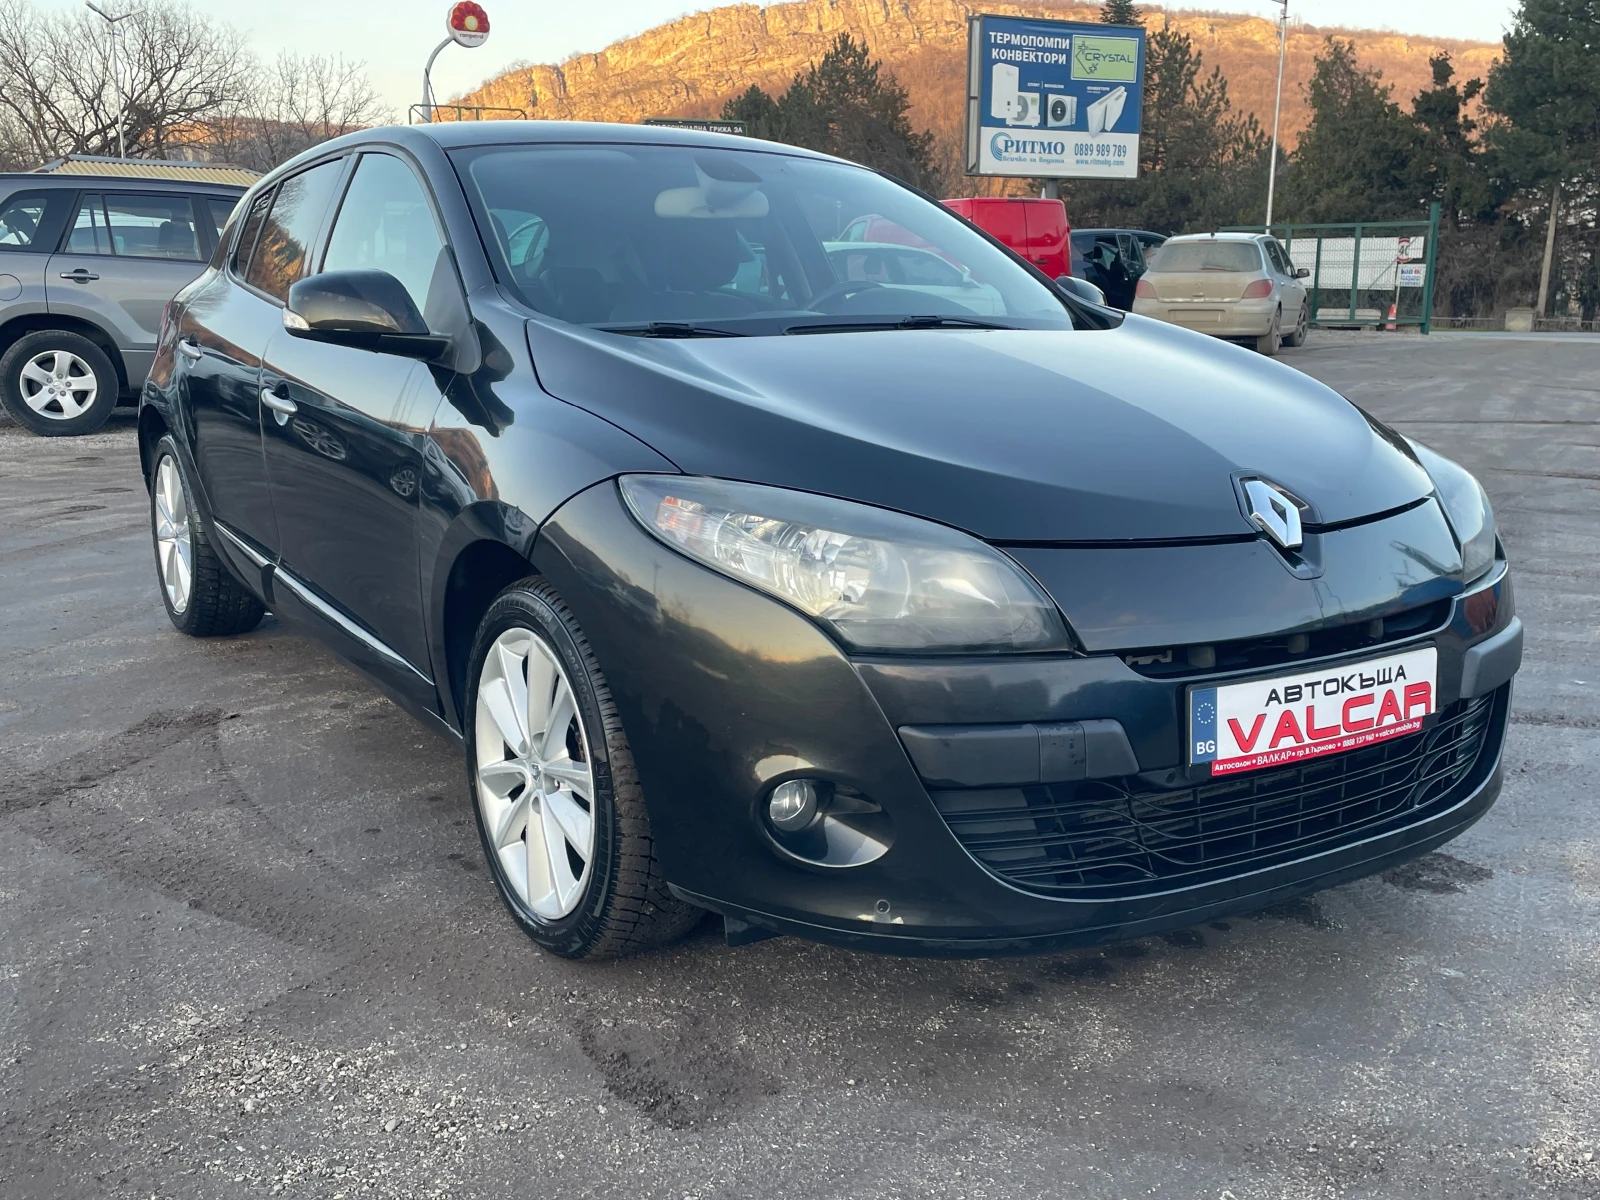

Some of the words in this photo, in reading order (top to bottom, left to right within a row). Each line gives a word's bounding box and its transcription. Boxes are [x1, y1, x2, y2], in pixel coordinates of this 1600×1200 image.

[989, 32, 1070, 49] ТЕРМОПОМПИ
[991, 48, 1067, 64] КОНВЕКТОРИ
[1085, 52, 1134, 63] CRYSTAL
[709, 125, 732, 133] ГРИЖА
[1003, 139, 1065, 155] РИТМО
[1074, 143, 1093, 157] 0889
[1096, 143, 1111, 157] 989
[1112, 144, 1127, 157] 789
[1075, 158, 1125, 167] www.ritmobg.com
[1265, 664, 1407, 707] АВТОКЪЩА
[1227, 681, 1431, 753] VALCAR
[1196, 740, 1216, 755] BG
[1214, 759, 1251, 772] Автосалон
[1257, 752, 1292, 766] ВАЛКАР
